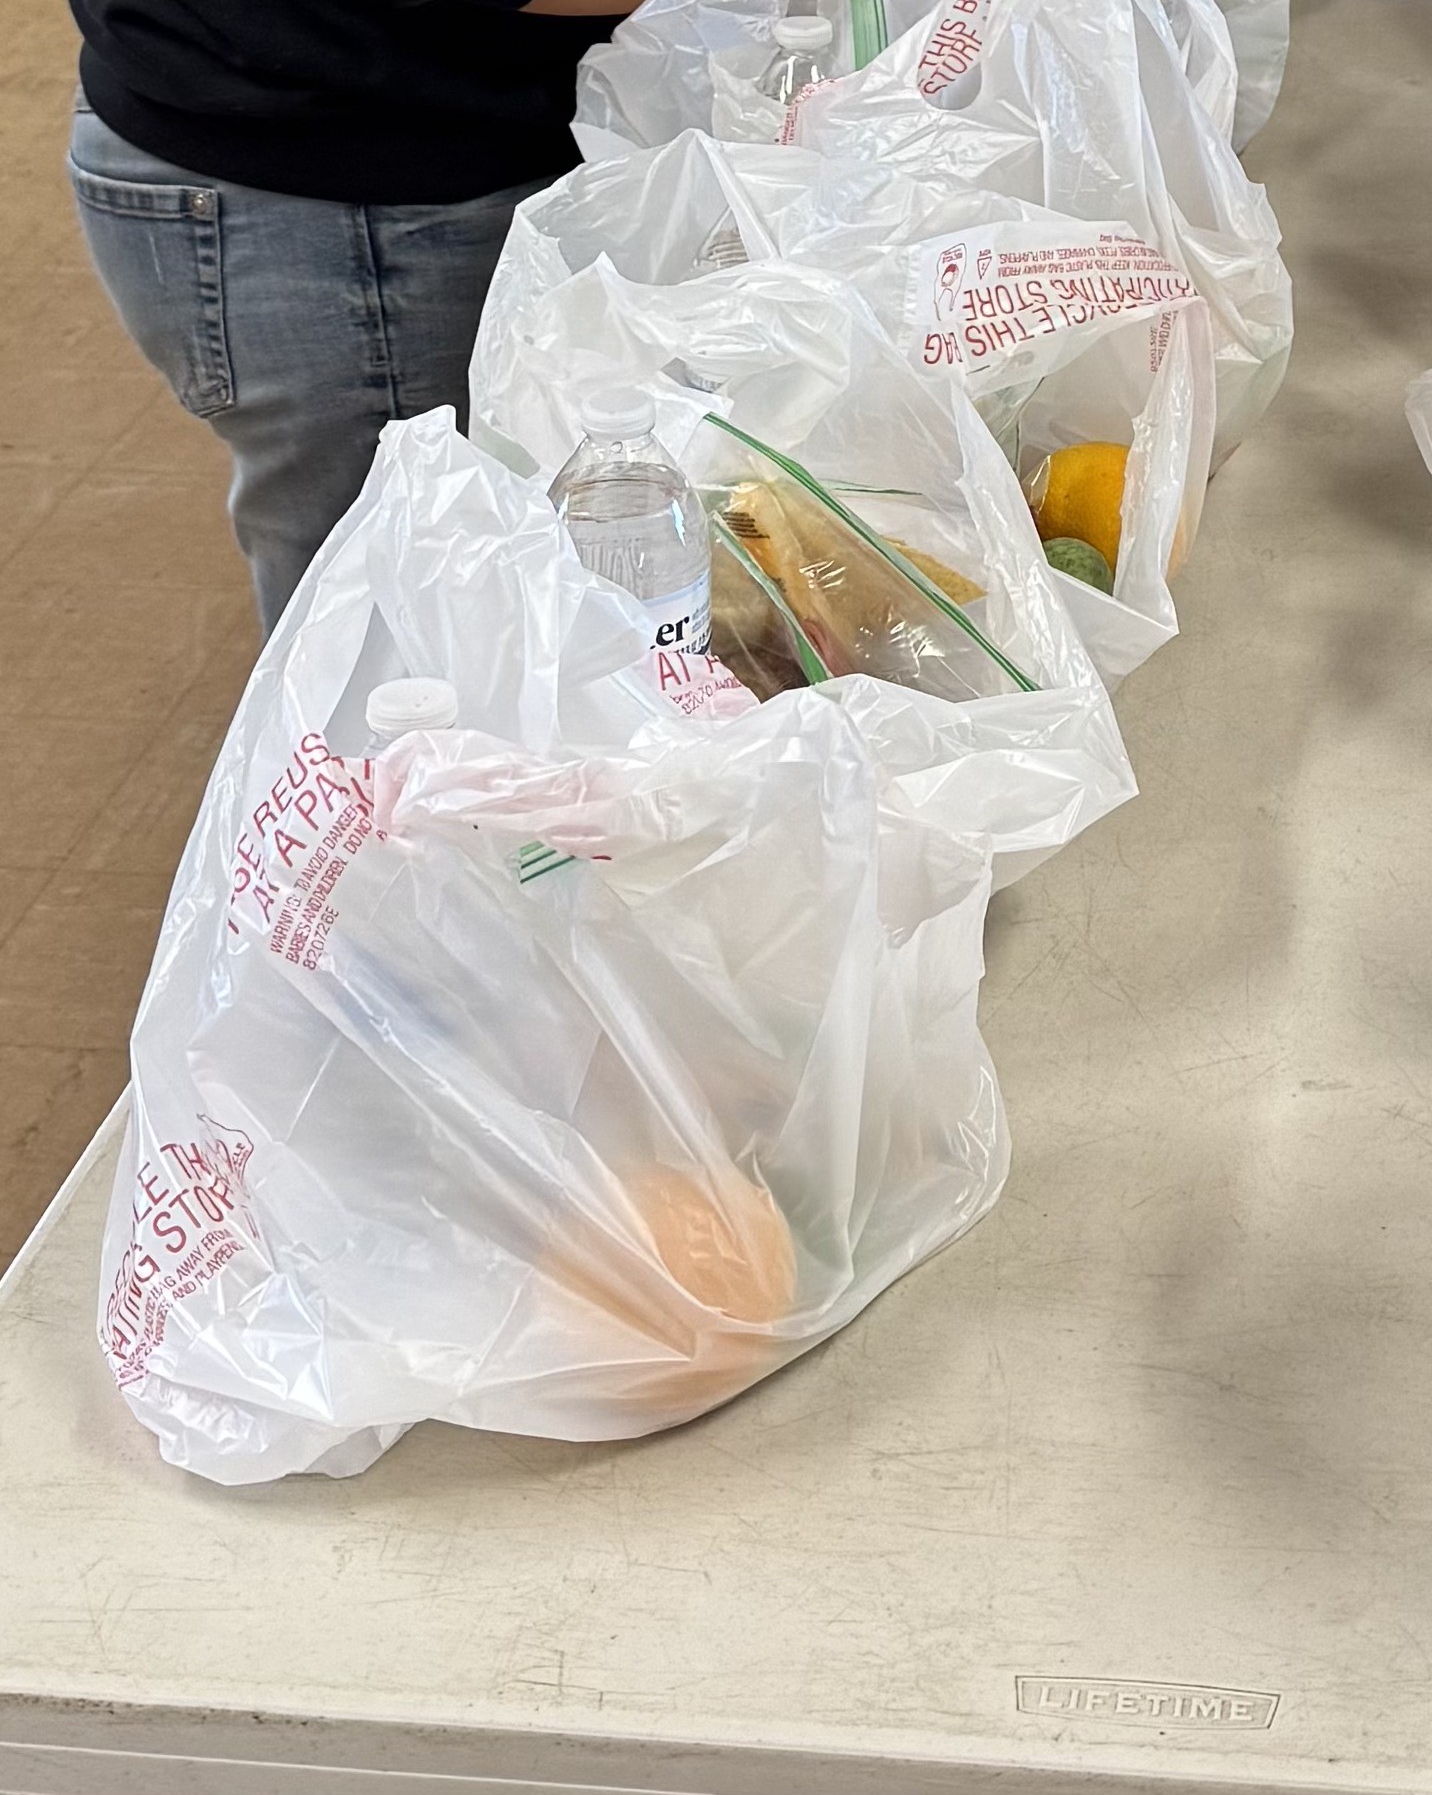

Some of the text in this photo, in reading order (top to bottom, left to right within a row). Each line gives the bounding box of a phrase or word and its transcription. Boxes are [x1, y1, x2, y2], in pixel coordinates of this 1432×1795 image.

[918, 19, 967, 69] THIS
[963, 280, 1049, 322] STORE
[964, 316, 1036, 358] THIS
[253, 733, 329, 837] REUS
[274, 829, 307, 868] A
[176, 1245, 204, 1281] AWAY
[172, 1280, 197, 1301] AND
[1038, 1685, 1256, 1722] LIFETIME
